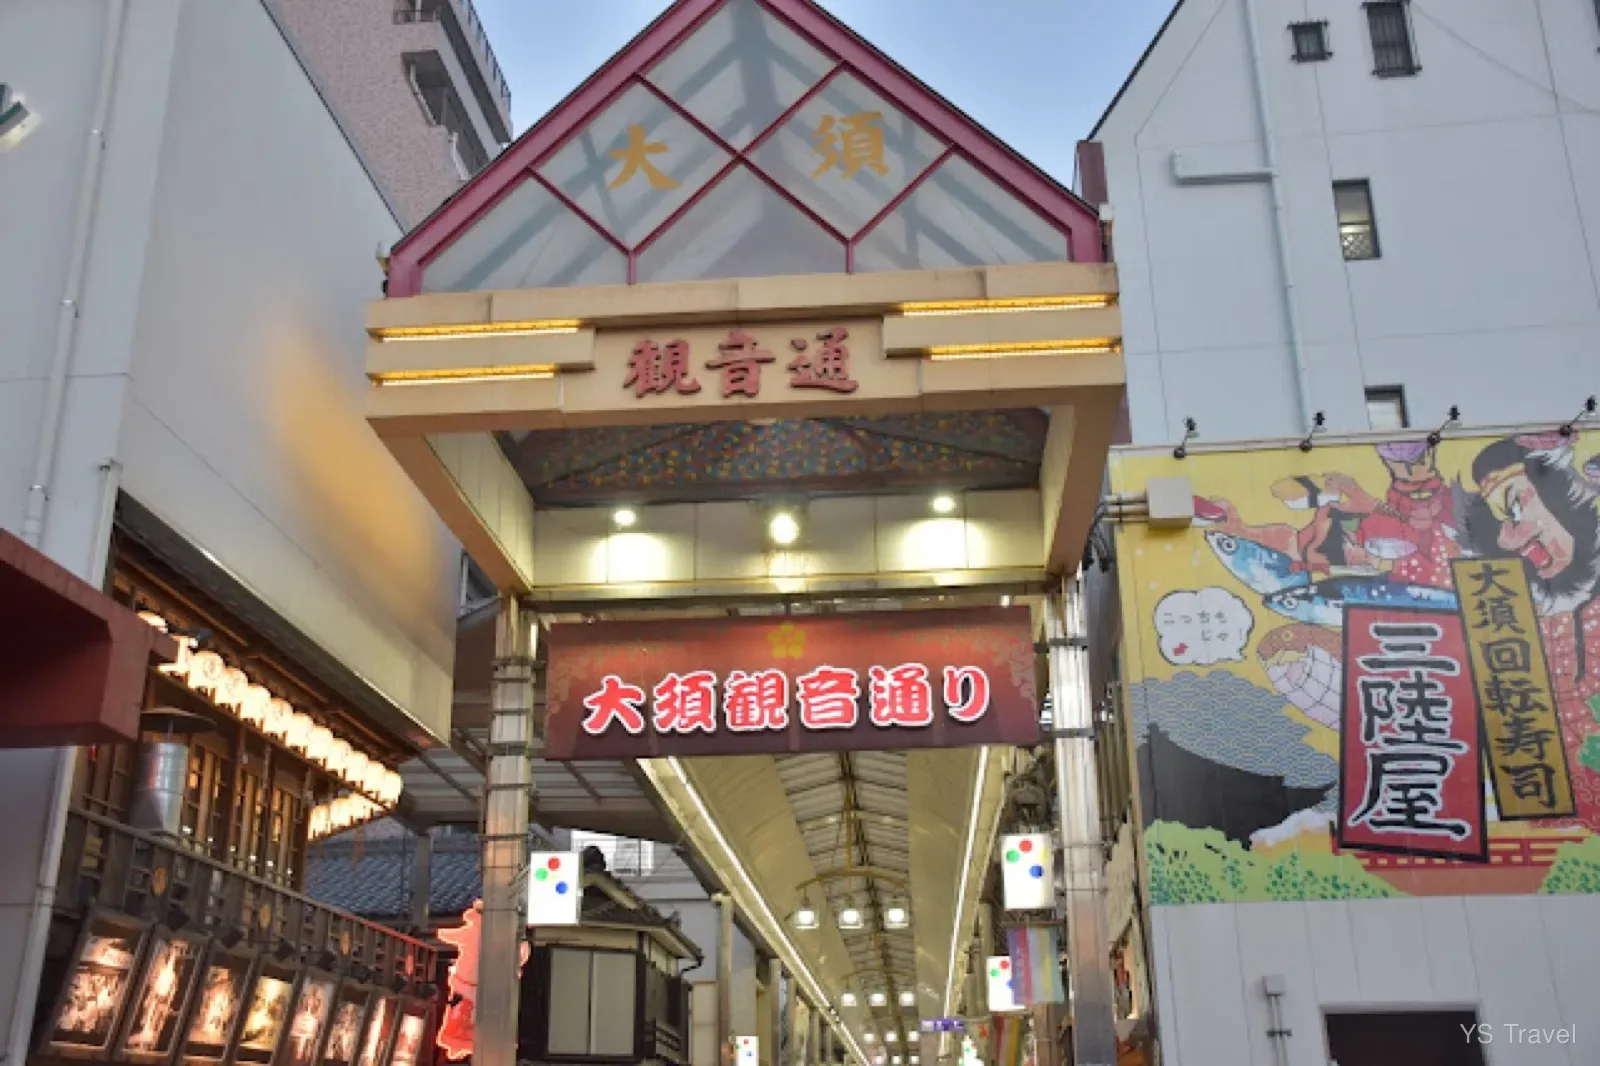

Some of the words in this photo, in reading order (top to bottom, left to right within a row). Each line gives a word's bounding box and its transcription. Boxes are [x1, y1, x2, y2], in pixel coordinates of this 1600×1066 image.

[622, 326, 858, 399] 観音通
[582, 662, 992, 735] 大須観音通り
[1347, 622, 1472, 841] 三陸屋
[1470, 563, 1556, 808] 大須回転寿司
